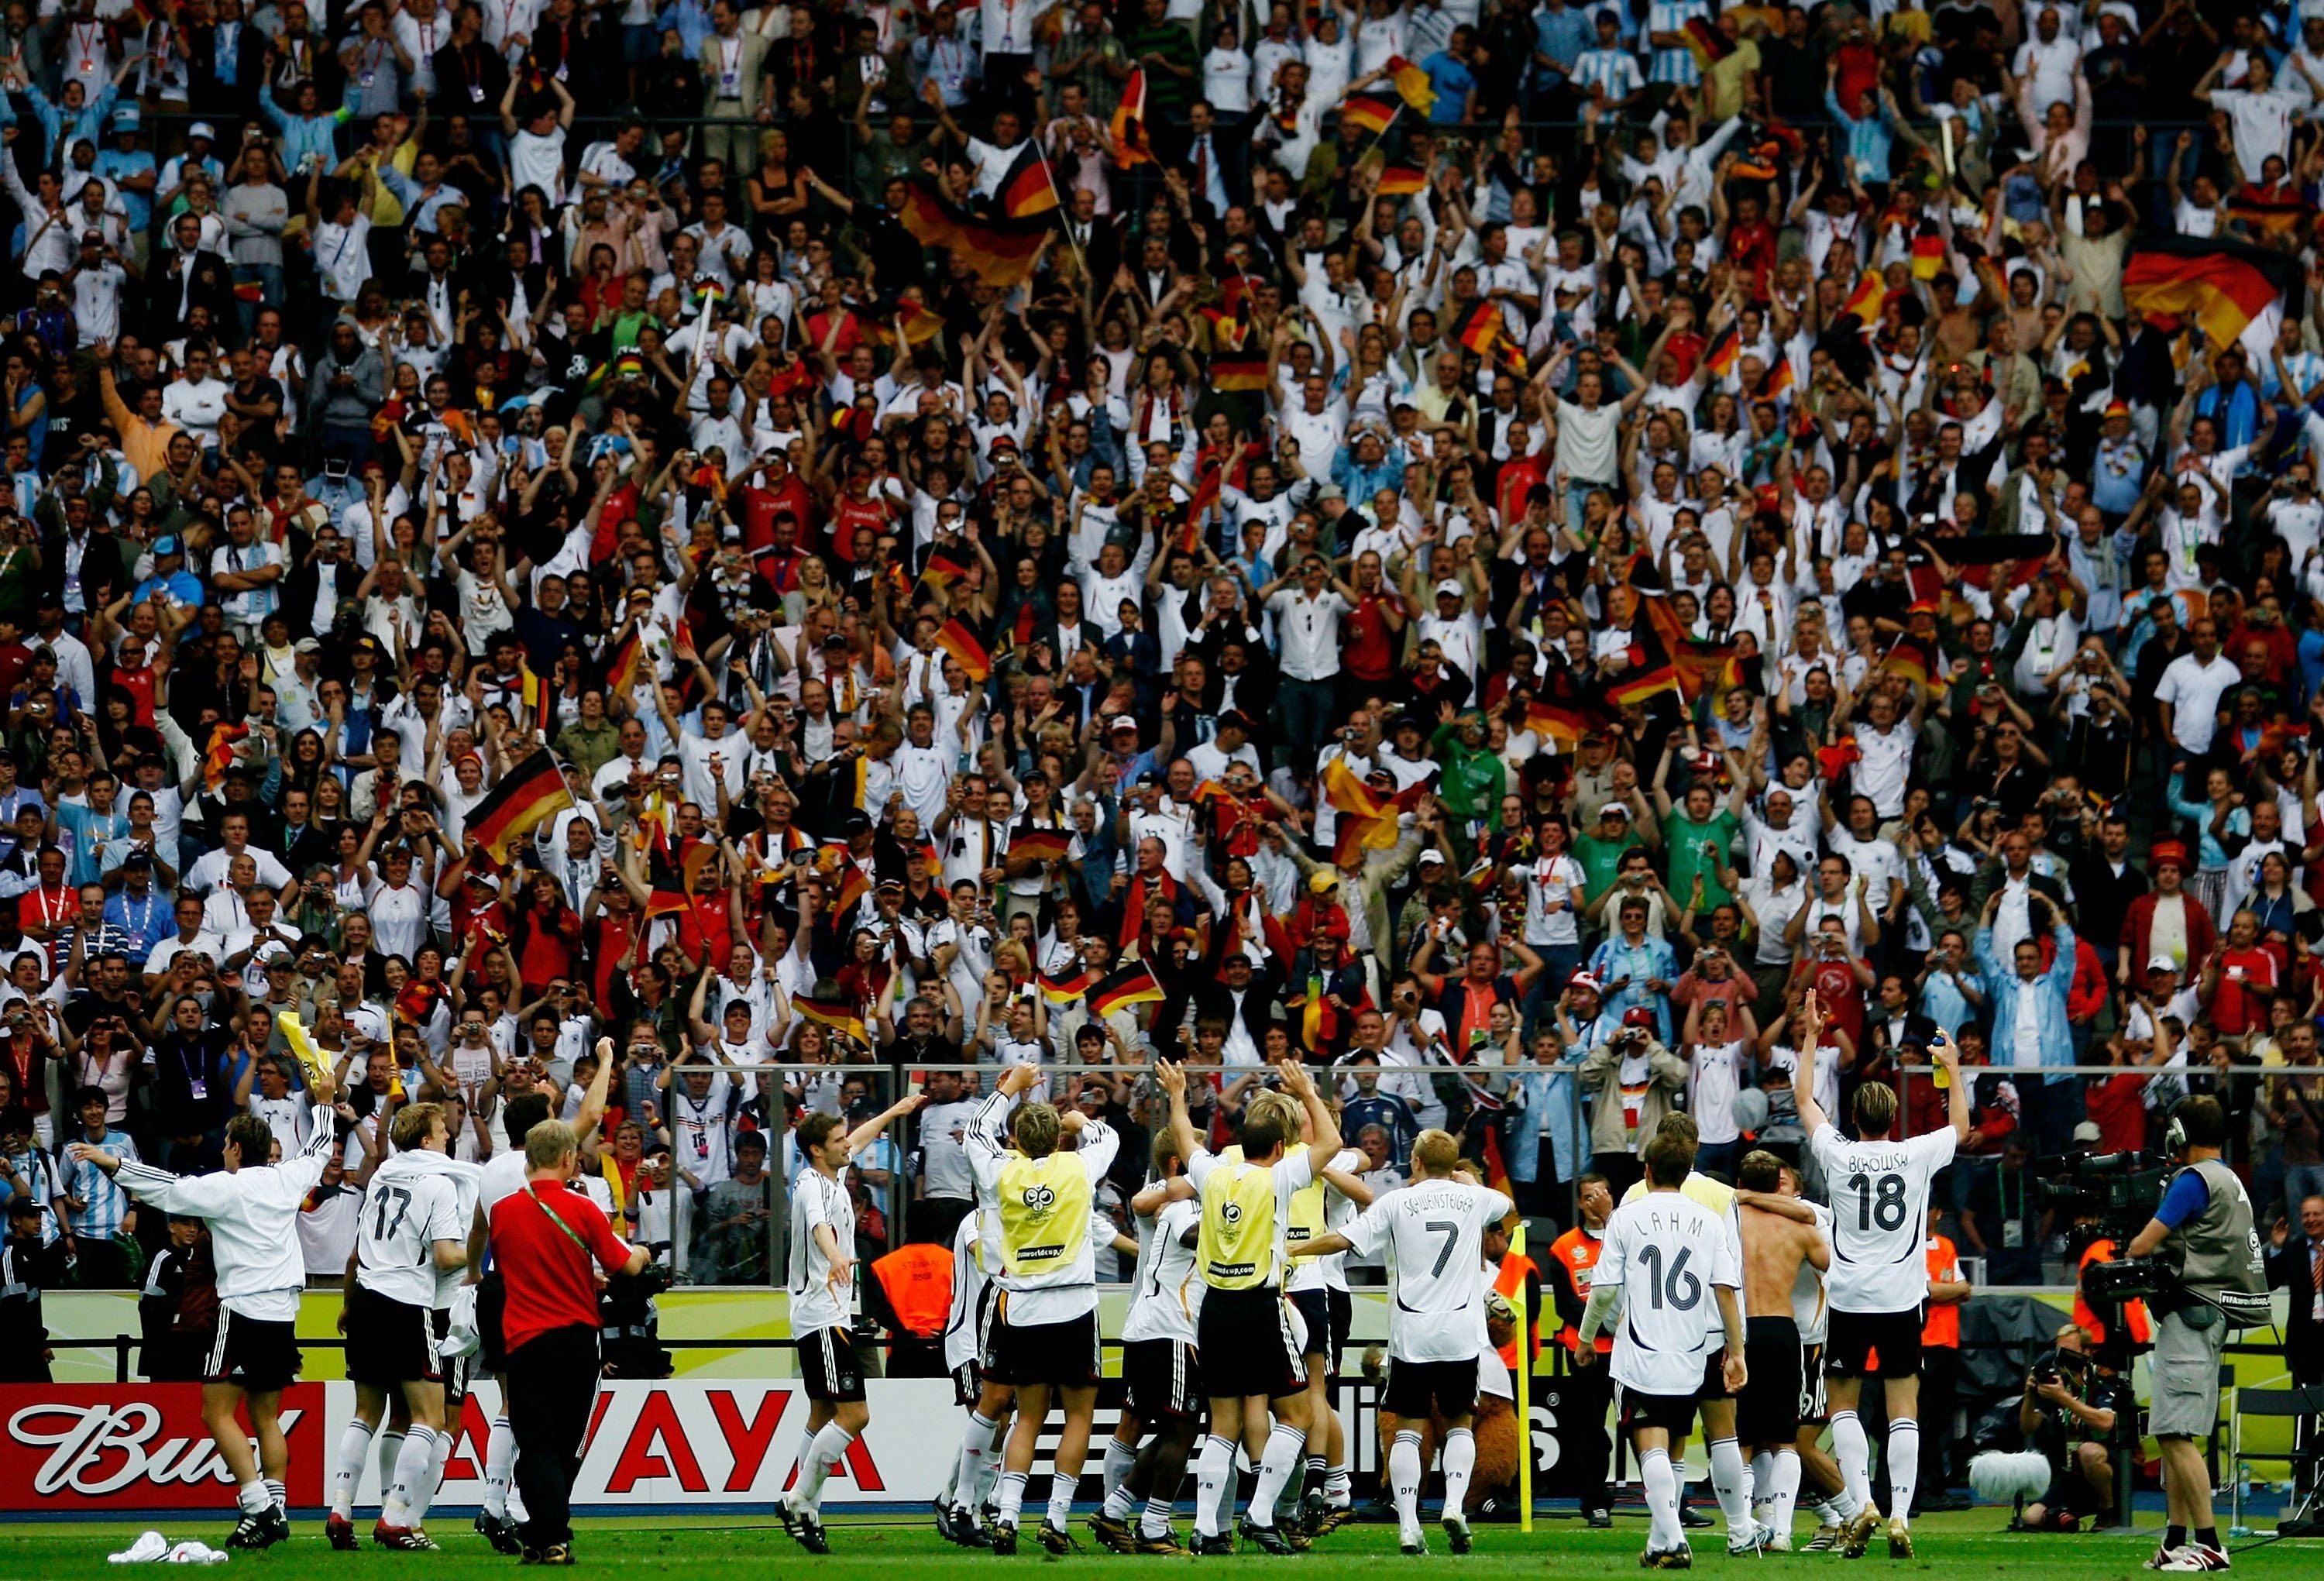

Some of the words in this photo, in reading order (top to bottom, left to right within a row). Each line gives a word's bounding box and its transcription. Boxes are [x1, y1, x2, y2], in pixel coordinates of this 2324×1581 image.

[374, 1186, 411, 1241] 17
[1634, 1212, 1703, 1238] LAHM
[1848, 1174, 1906, 1232] 18
[1425, 1221, 1459, 1279] 7
[1638, 1244, 1701, 1311] 16
